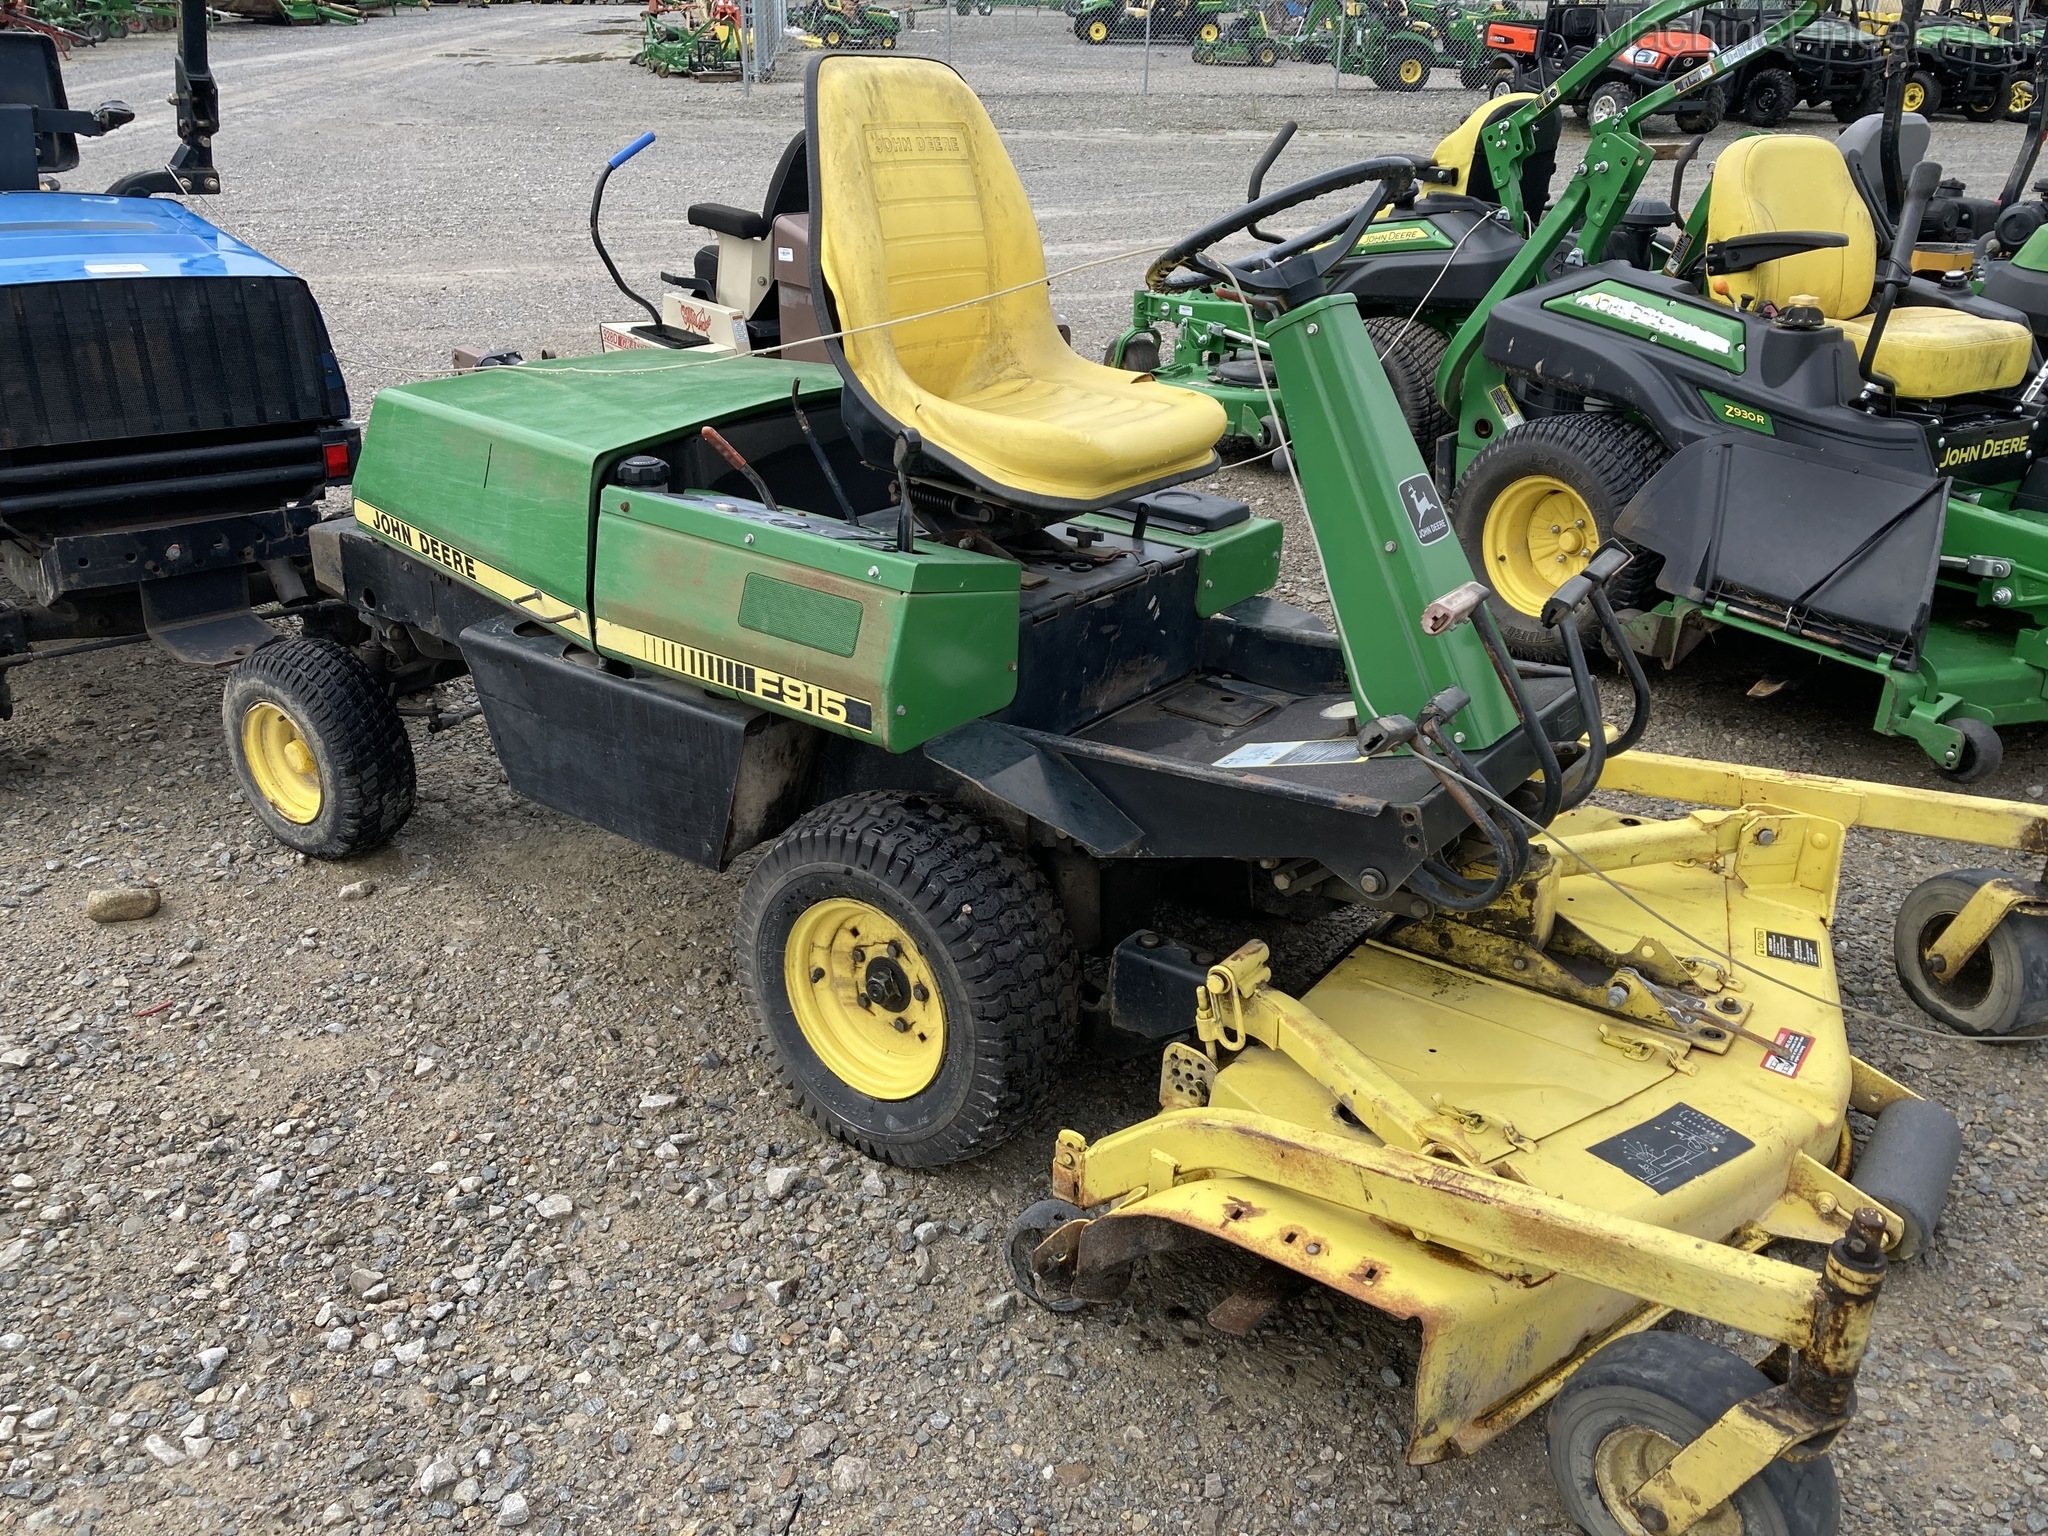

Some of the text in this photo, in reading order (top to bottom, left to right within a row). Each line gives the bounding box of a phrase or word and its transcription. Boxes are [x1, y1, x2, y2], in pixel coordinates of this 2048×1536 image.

[875, 136, 960, 153] JOHN DEERE
[1363, 231, 1418, 244] JOHN DEERE
[1939, 435, 2030, 468] JOHN DEERE
[1419, 519, 1447, 539] JOHN DEERE
[373, 511, 477, 580] JOHN DEERE
[754, 668, 848, 723] F915
